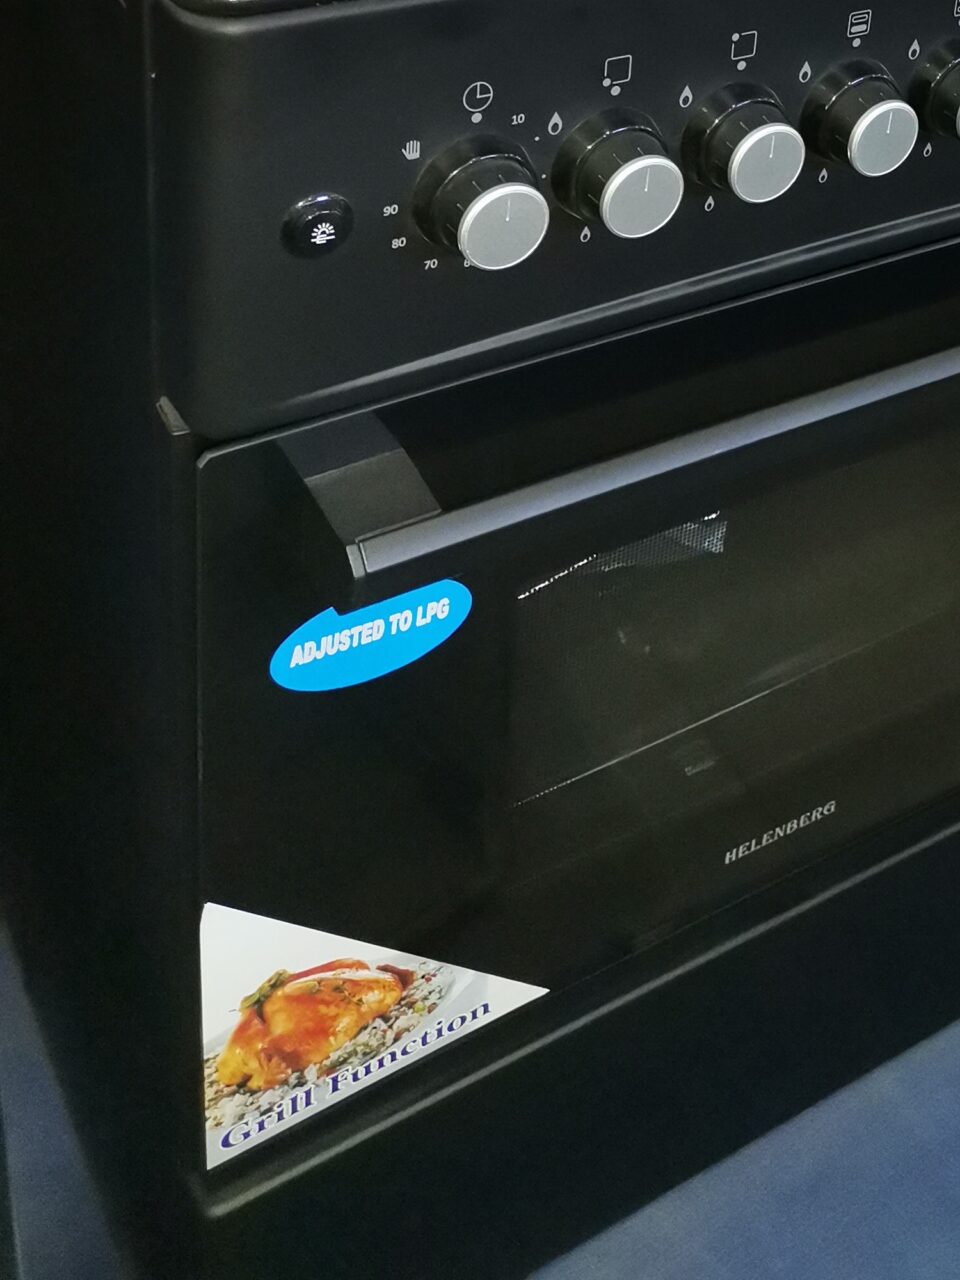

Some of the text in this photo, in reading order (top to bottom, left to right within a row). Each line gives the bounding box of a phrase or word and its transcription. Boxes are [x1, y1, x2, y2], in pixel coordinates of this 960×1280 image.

[511, 113, 526, 125] 10
[383, 204, 398, 217] 90
[391, 236, 407, 249] 80
[423, 258, 438, 270] 70
[289, 597, 451, 669] ADJUSTED TO LPG
[724, 800, 837, 865] HELENBERG
[219, 1000, 492, 1151] Grill Function
